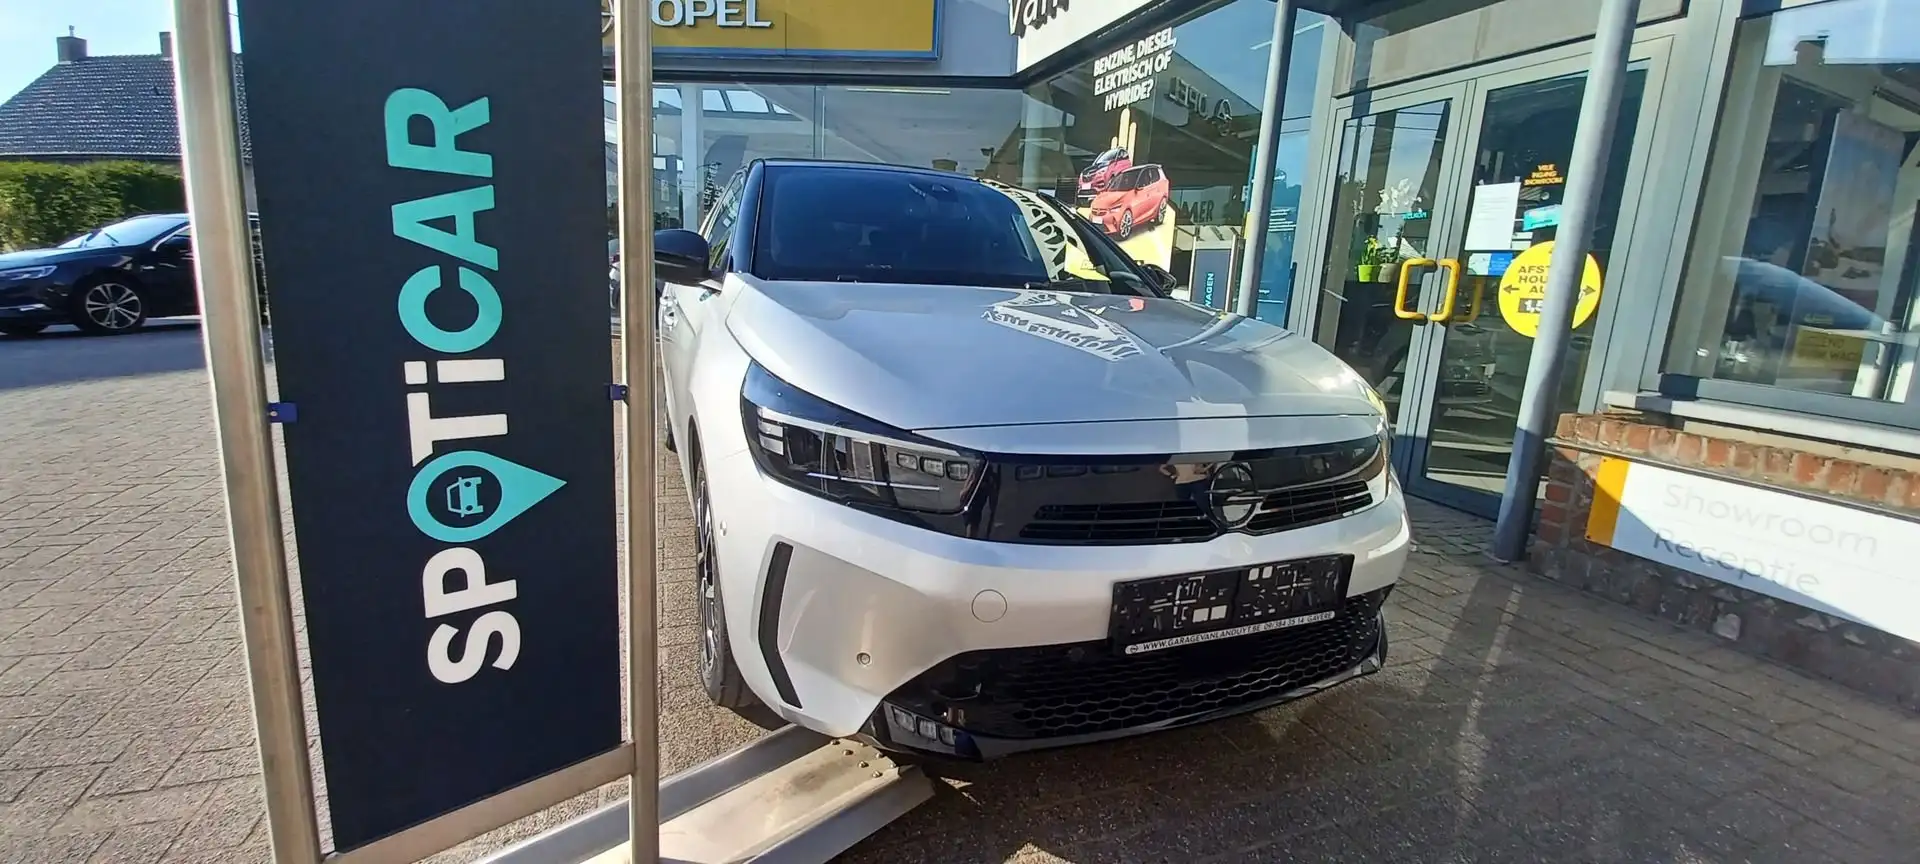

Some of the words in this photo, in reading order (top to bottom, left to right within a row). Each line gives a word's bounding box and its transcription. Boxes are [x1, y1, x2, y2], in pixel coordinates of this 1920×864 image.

[651, 0, 772, 27] OPEL
[1093, 44, 1136, 77] BENZINE,
[1137, 27, 1177, 59] DIESEL,
[1094, 57, 1154, 96] ELEKTRISCH
[1154, 50, 1173, 73] OF
[1104, 78, 1154, 112] HYBRIDE?
[1524, 176, 1564, 187] SHOWROOM
[1662, 482, 1879, 558] Showroom
[1653, 527, 1820, 595] Receptie
[1307, 612, 1333, 623] GAVERE
